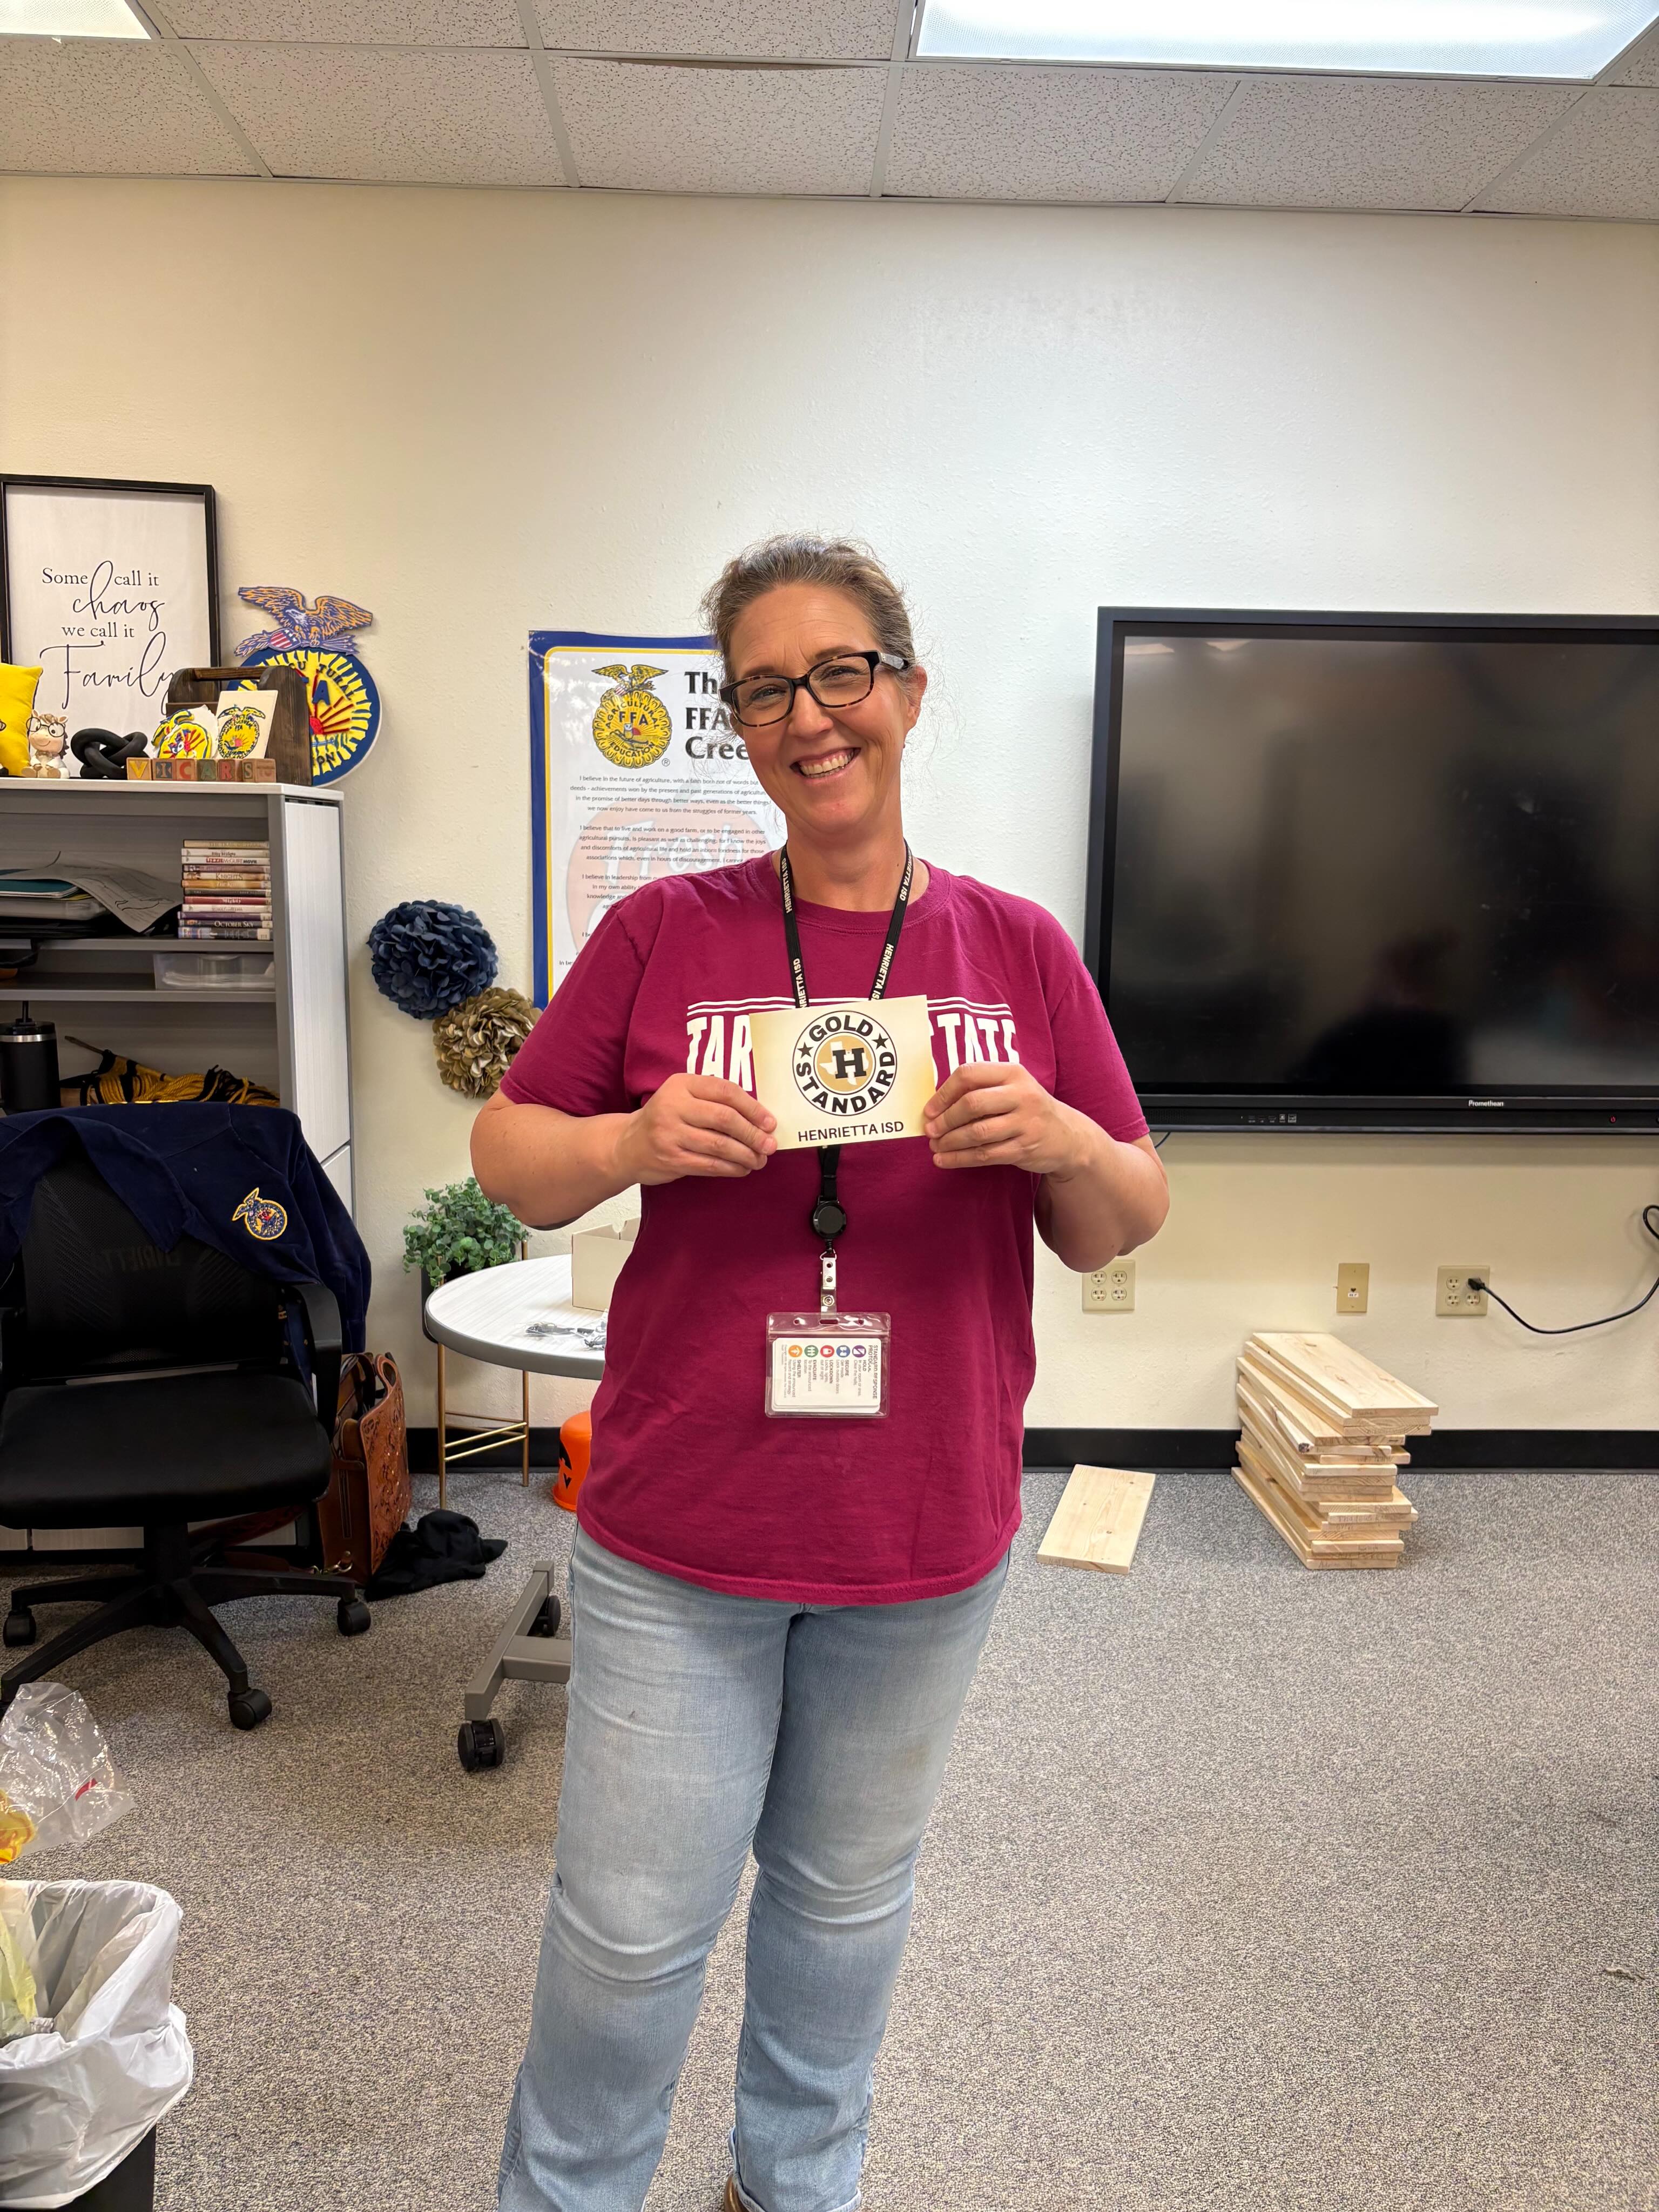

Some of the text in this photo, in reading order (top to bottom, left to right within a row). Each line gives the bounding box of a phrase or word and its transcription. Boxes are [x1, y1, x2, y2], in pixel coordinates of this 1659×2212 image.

[42, 568, 159, 586] Some call it
[73, 561, 165, 631] chaos
[62, 622, 134, 637] we call it
[684, 671, 718, 694] Th
[605, 701, 659, 729] AGRICULTURAL
[619, 711, 648, 725] FFA
[686, 707, 732, 730] FFA
[610, 741, 656, 757] EDUCATION
[685, 736, 749, 760] Cree
[783, 870, 792, 914] HENRIETTA
[900, 886, 908, 901] ISD
[793, 958, 801, 973] ISD
[872, 943, 894, 1000] HENRIETTA IS
[809, 1015, 873, 1042] GOLD
[686, 1014, 753, 1092] TAR
[832, 1047, 867, 1079] H
[929, 1013, 1020, 1091] TATE
[796, 1051, 895, 1114] STANDARD
[798, 1121, 904, 1142] HENRIETTA ISD
